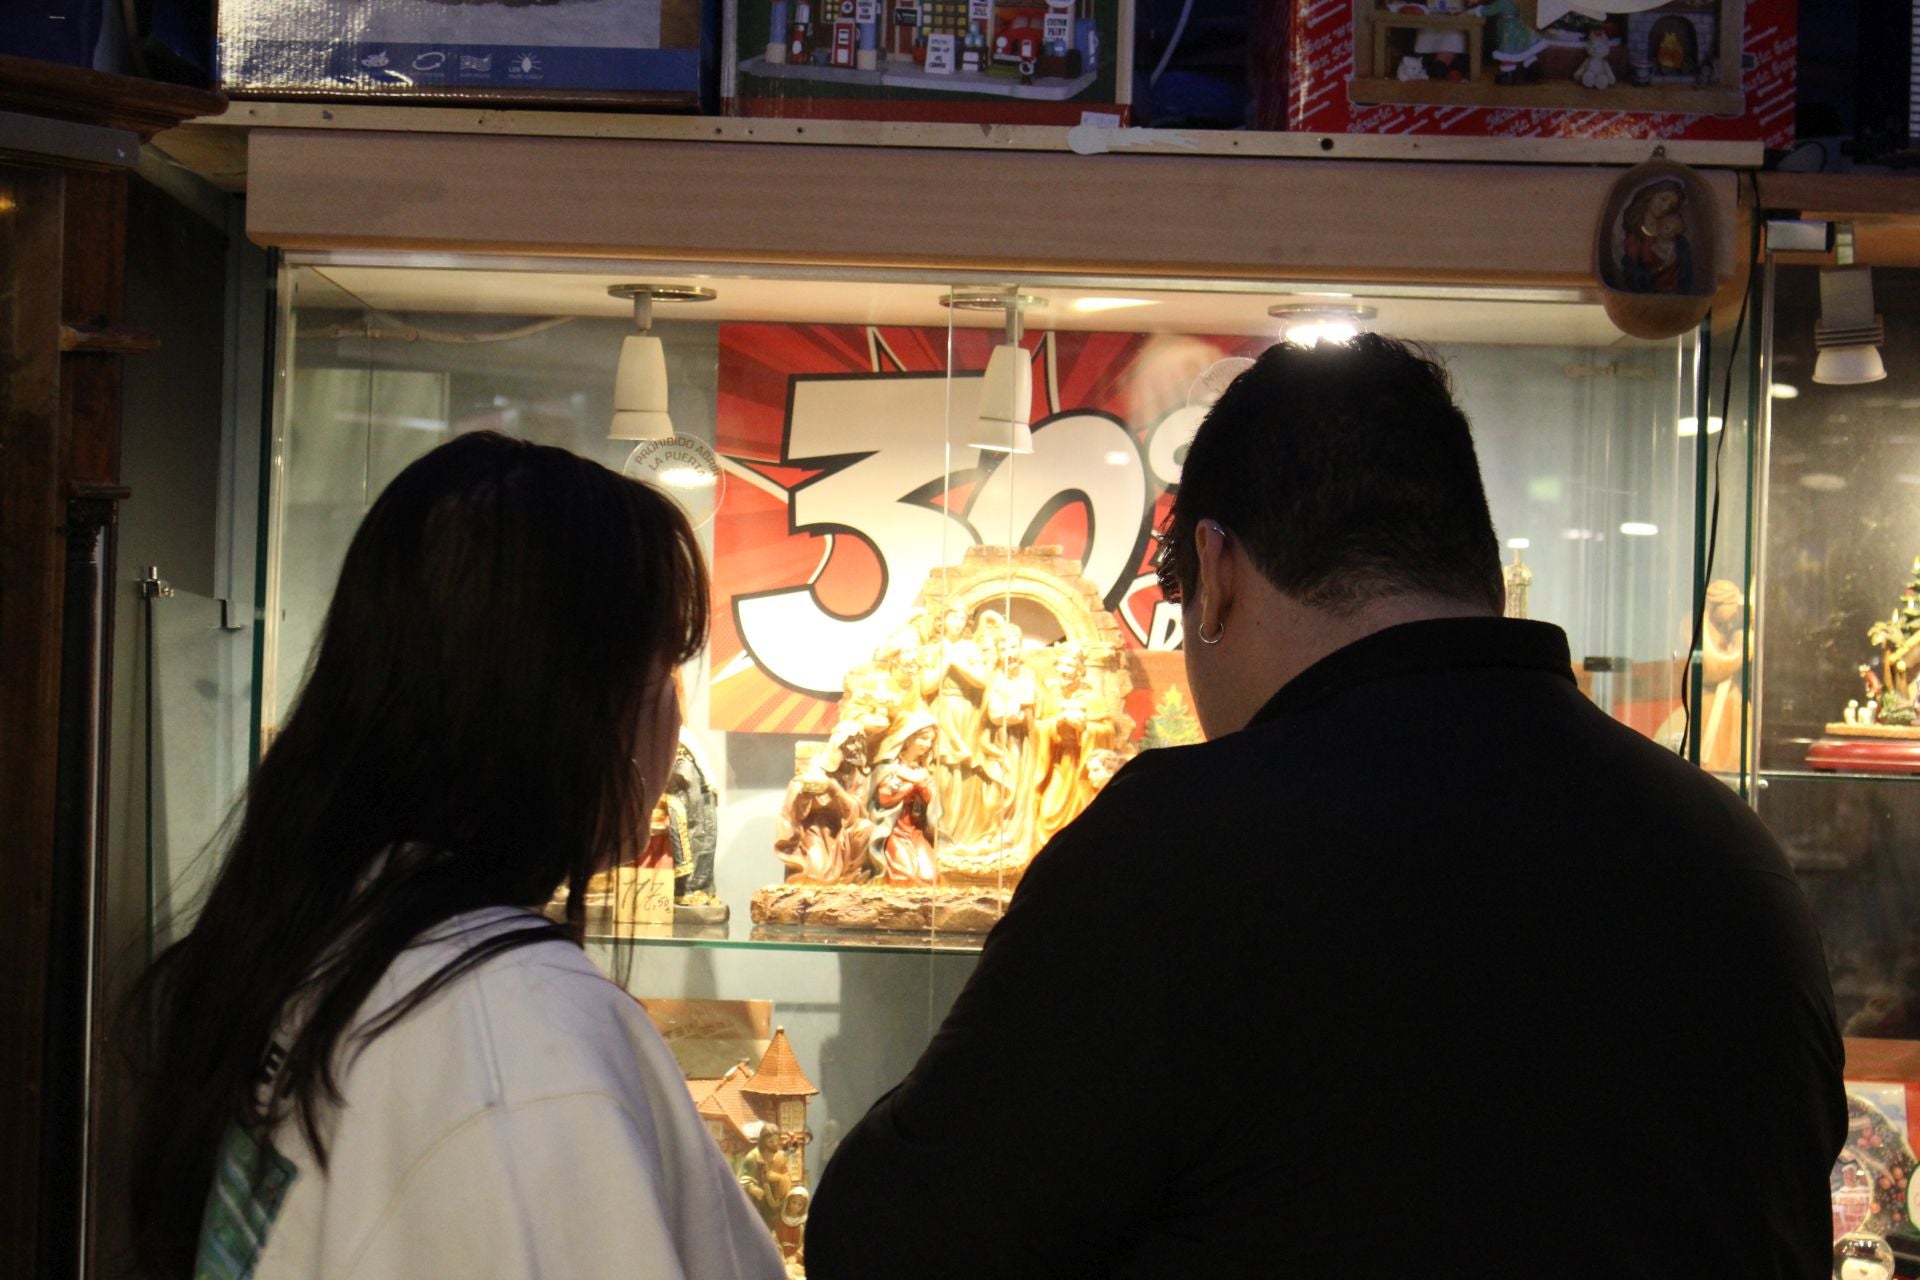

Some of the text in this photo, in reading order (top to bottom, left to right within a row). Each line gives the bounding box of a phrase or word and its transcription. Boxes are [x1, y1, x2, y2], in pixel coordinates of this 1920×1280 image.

[635, 437, 695, 465] PROHIBIDO
[648, 457, 664, 471] LA
[731, 370, 1189, 697] 30
